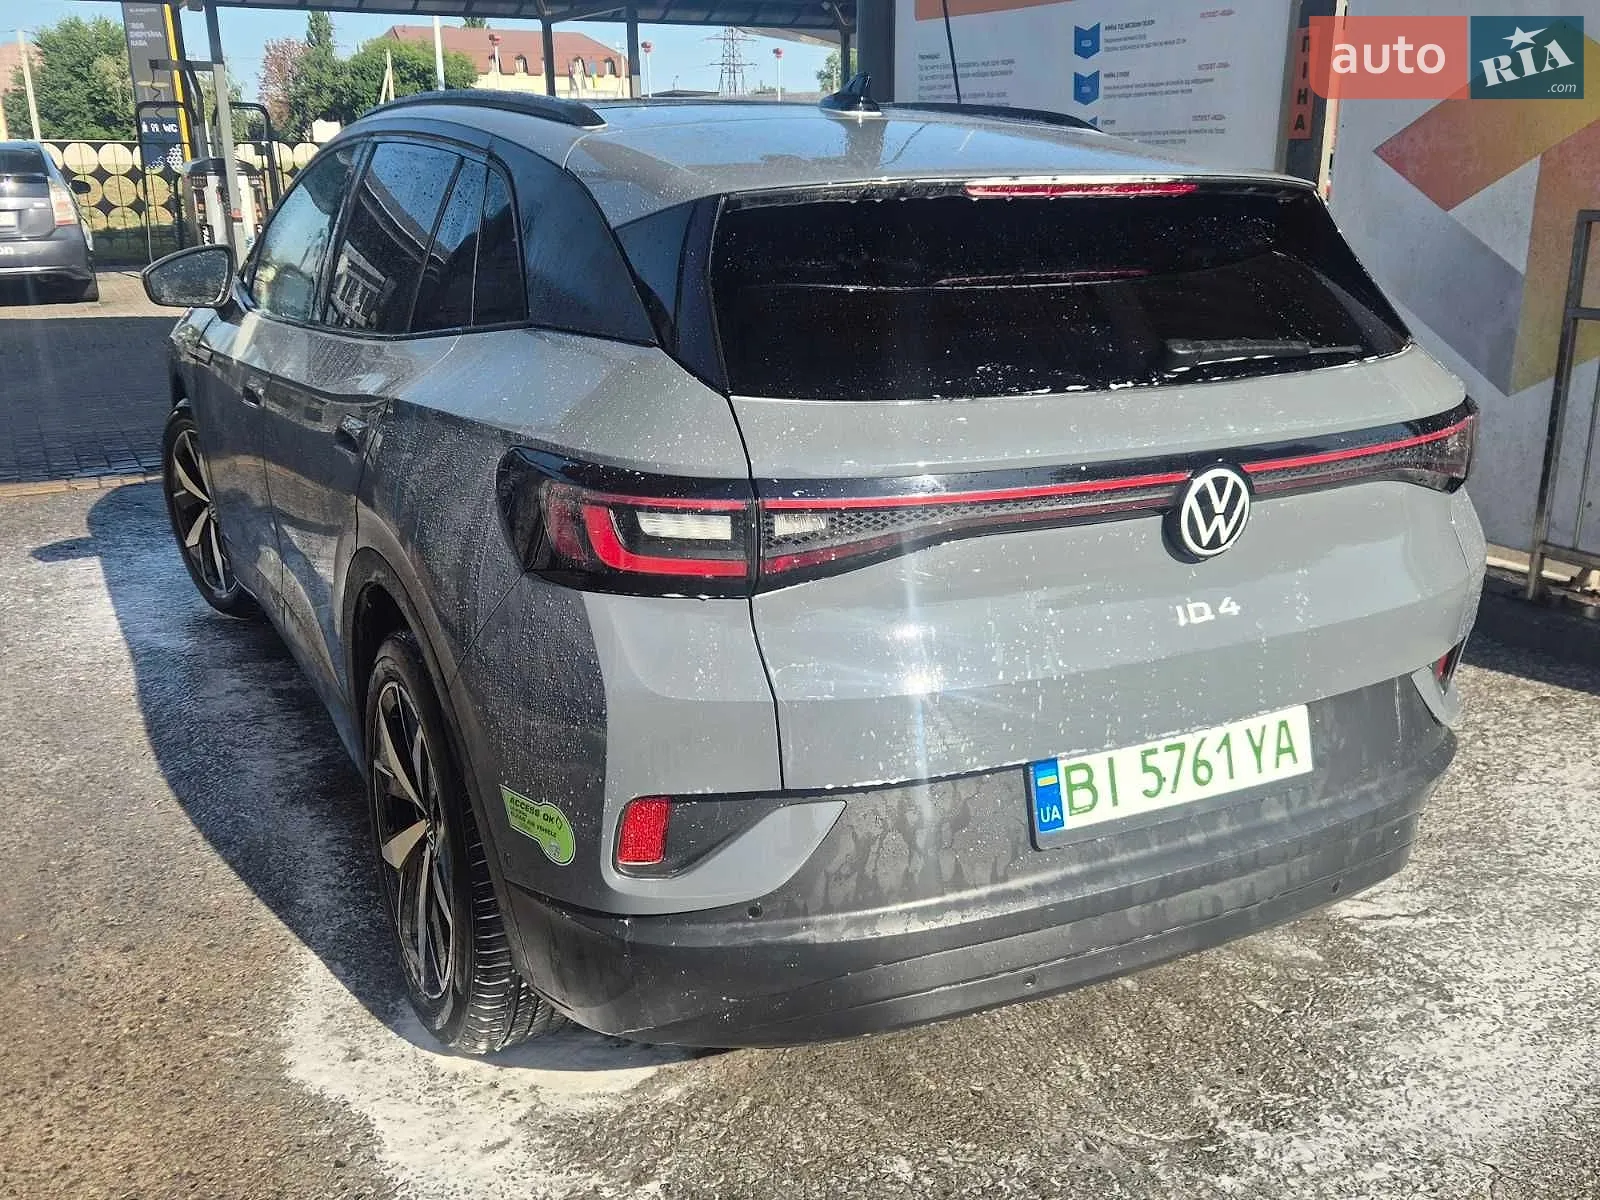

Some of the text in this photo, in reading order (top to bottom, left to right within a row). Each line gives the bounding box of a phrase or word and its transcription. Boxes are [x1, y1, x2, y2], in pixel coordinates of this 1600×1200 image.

[162, 123, 178, 133] WC
[1064, 720, 1298, 816] BI 5761 YA
[509, 797, 540, 818] ACCESS
[1040, 805, 1063, 823] UA
